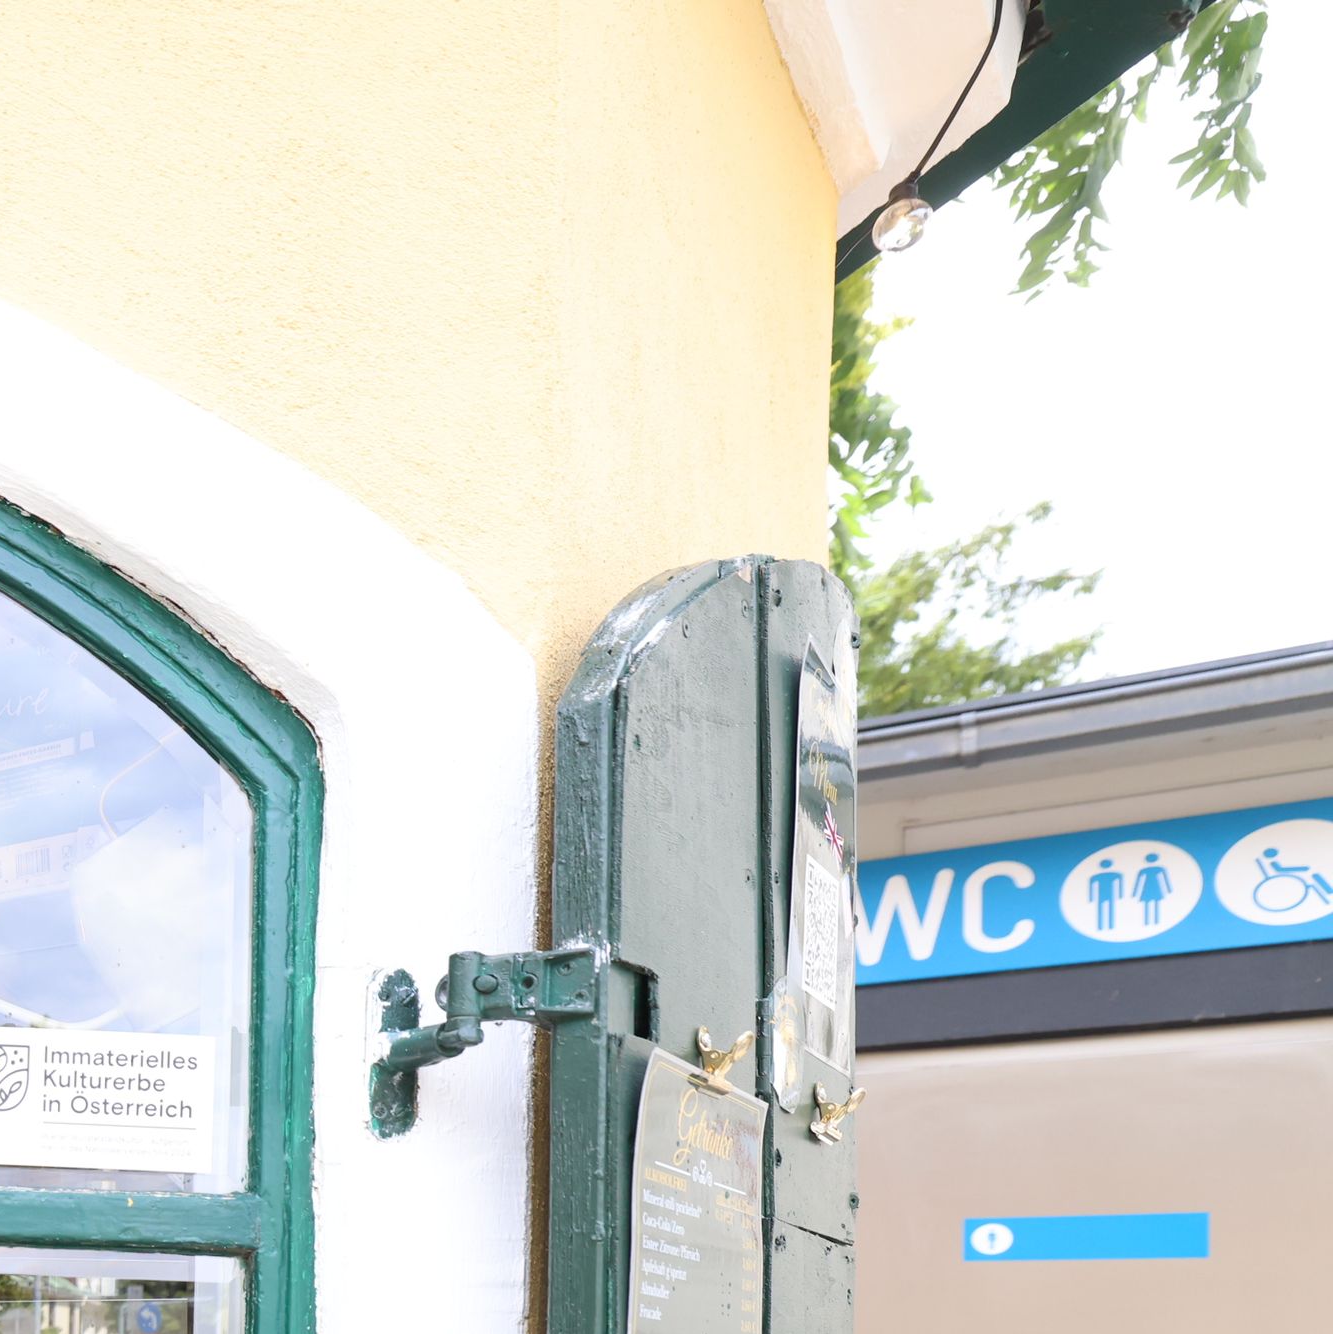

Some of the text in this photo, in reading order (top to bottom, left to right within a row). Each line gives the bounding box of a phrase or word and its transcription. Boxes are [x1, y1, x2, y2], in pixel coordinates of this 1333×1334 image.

[856, 860, 1035, 967] WC
[44, 1046, 198, 1070] Immaterielles
[44, 1069, 165, 1092] Kulturerbe
[43, 1090, 192, 1118] in Österreich
[674, 1088, 733, 1165] Getränke
